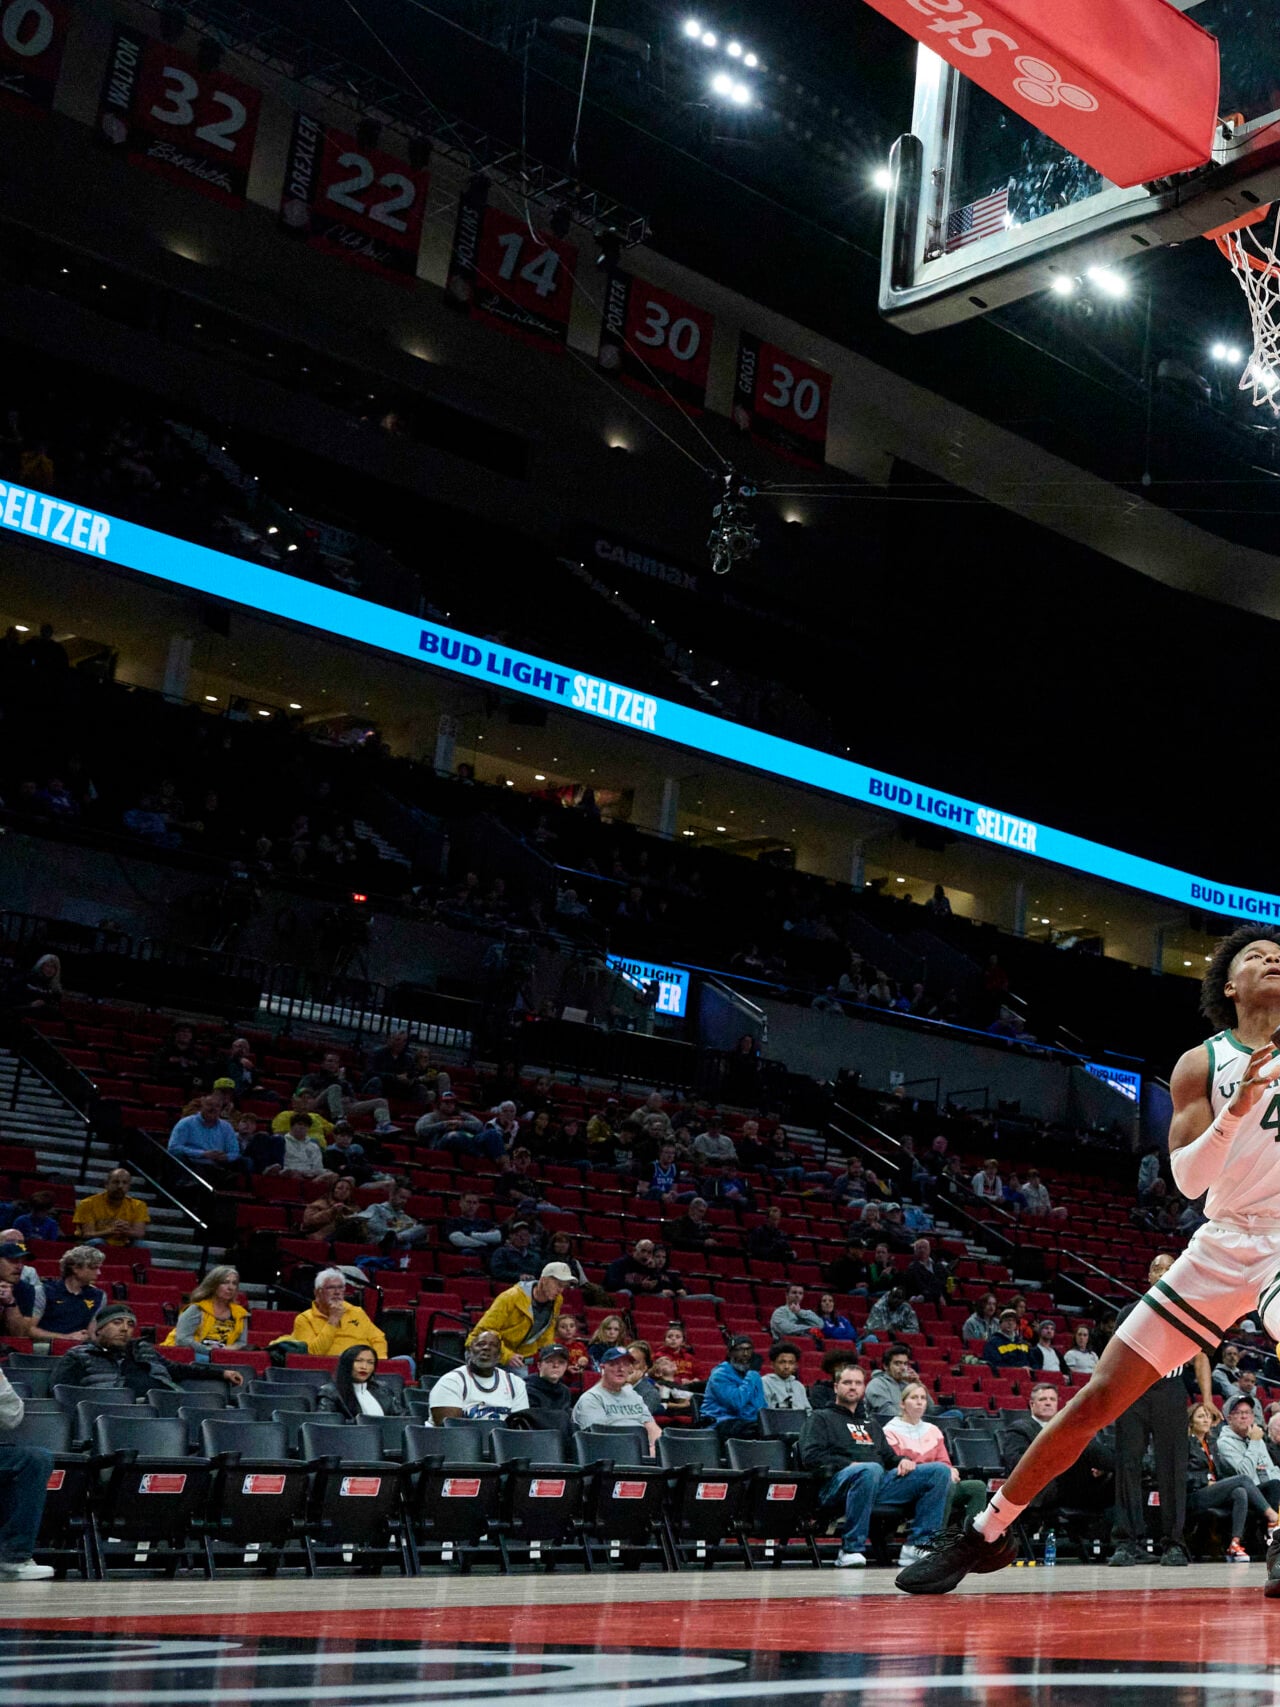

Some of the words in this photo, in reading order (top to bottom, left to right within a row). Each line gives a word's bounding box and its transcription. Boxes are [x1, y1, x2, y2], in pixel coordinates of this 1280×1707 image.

[107, 37, 141, 109] WALTON
[150, 66, 248, 153] 32
[290, 115, 322, 201] DREXLER
[326, 152, 416, 233] 22
[457, 206, 479, 267] HOLLINS
[499, 232, 561, 298] 14
[606, 279, 628, 334] PORTER
[634, 301, 700, 361] 30
[738, 347, 756, 395] GROSS
[763, 364, 821, 420] 30
[419, 630, 483, 666] BUD
[487, 652, 570, 695] LIGHT
[571, 674, 658, 731] SELTZER
[868, 777, 913, 806] BUD
[916, 793, 975, 827] LIGHT
[976, 807, 1037, 852] SELTZER
[1190, 884, 1225, 906] BUD
[644, 968, 683, 984] LIGHT
